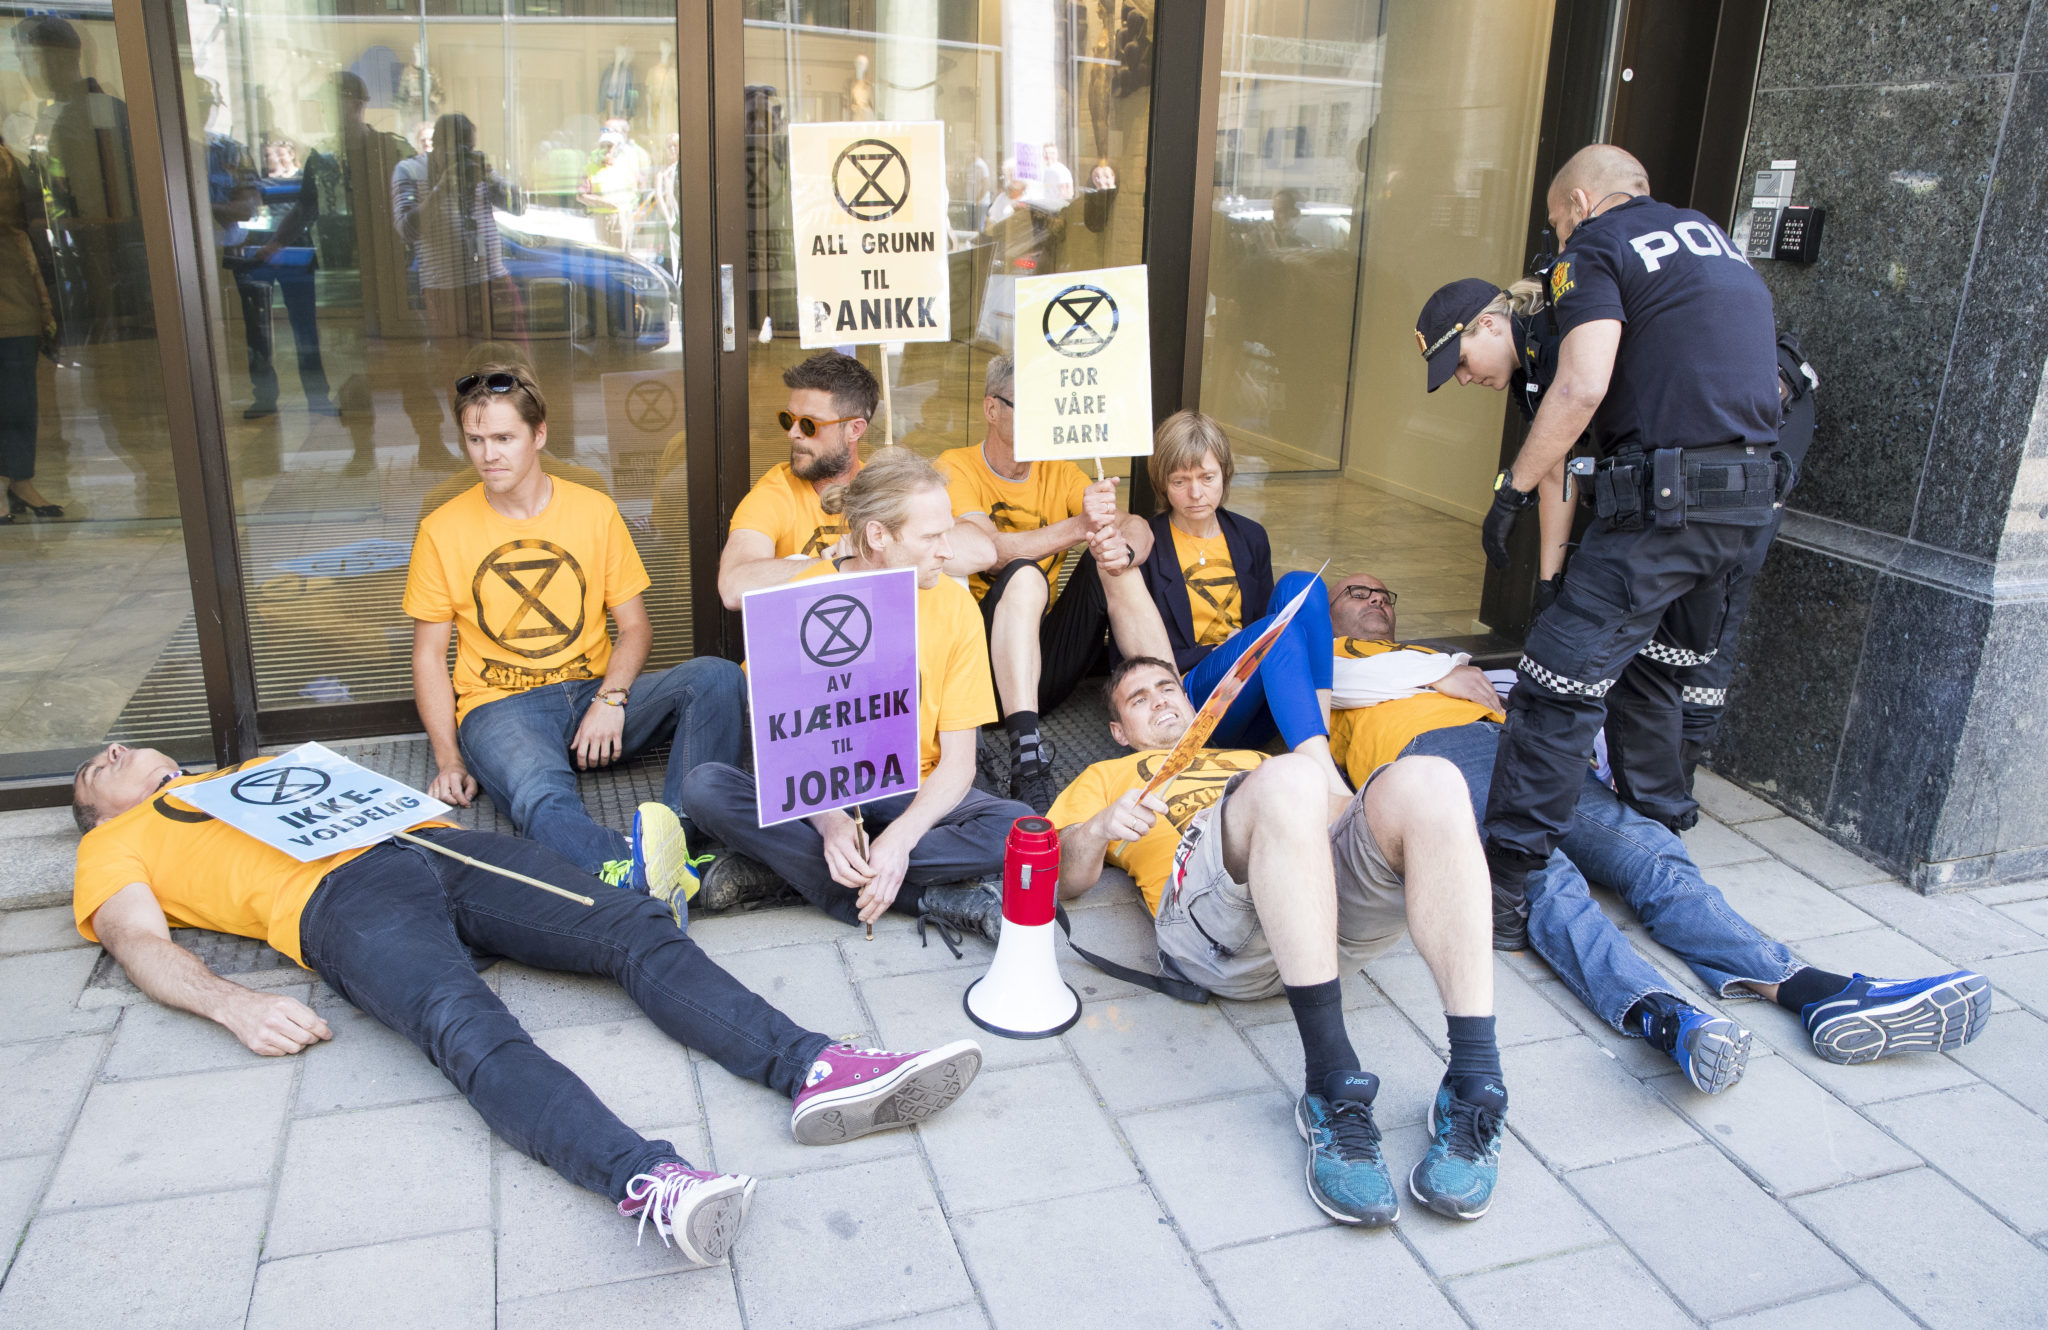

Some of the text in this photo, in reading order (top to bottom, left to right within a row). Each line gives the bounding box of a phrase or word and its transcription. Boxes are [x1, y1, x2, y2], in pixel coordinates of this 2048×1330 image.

[811, 231, 935, 256] ALL GRUNN
[1628, 220, 1754, 273] POL
[861, 269, 890, 290] TIL
[813, 296, 938, 334] PANIKK
[1060, 367, 1099, 387] FOR
[1054, 392, 1107, 416] VÅRE
[1053, 423, 1109, 446] BARN
[826, 672, 853, 693] AV
[768, 688, 910, 742] KJÆRLEIK
[831, 737, 853, 755] TIL
[781, 752, 905, 812] JORDA
[277, 787, 383, 829] IKKE-
[288, 796, 421, 847] VOLDELIG
